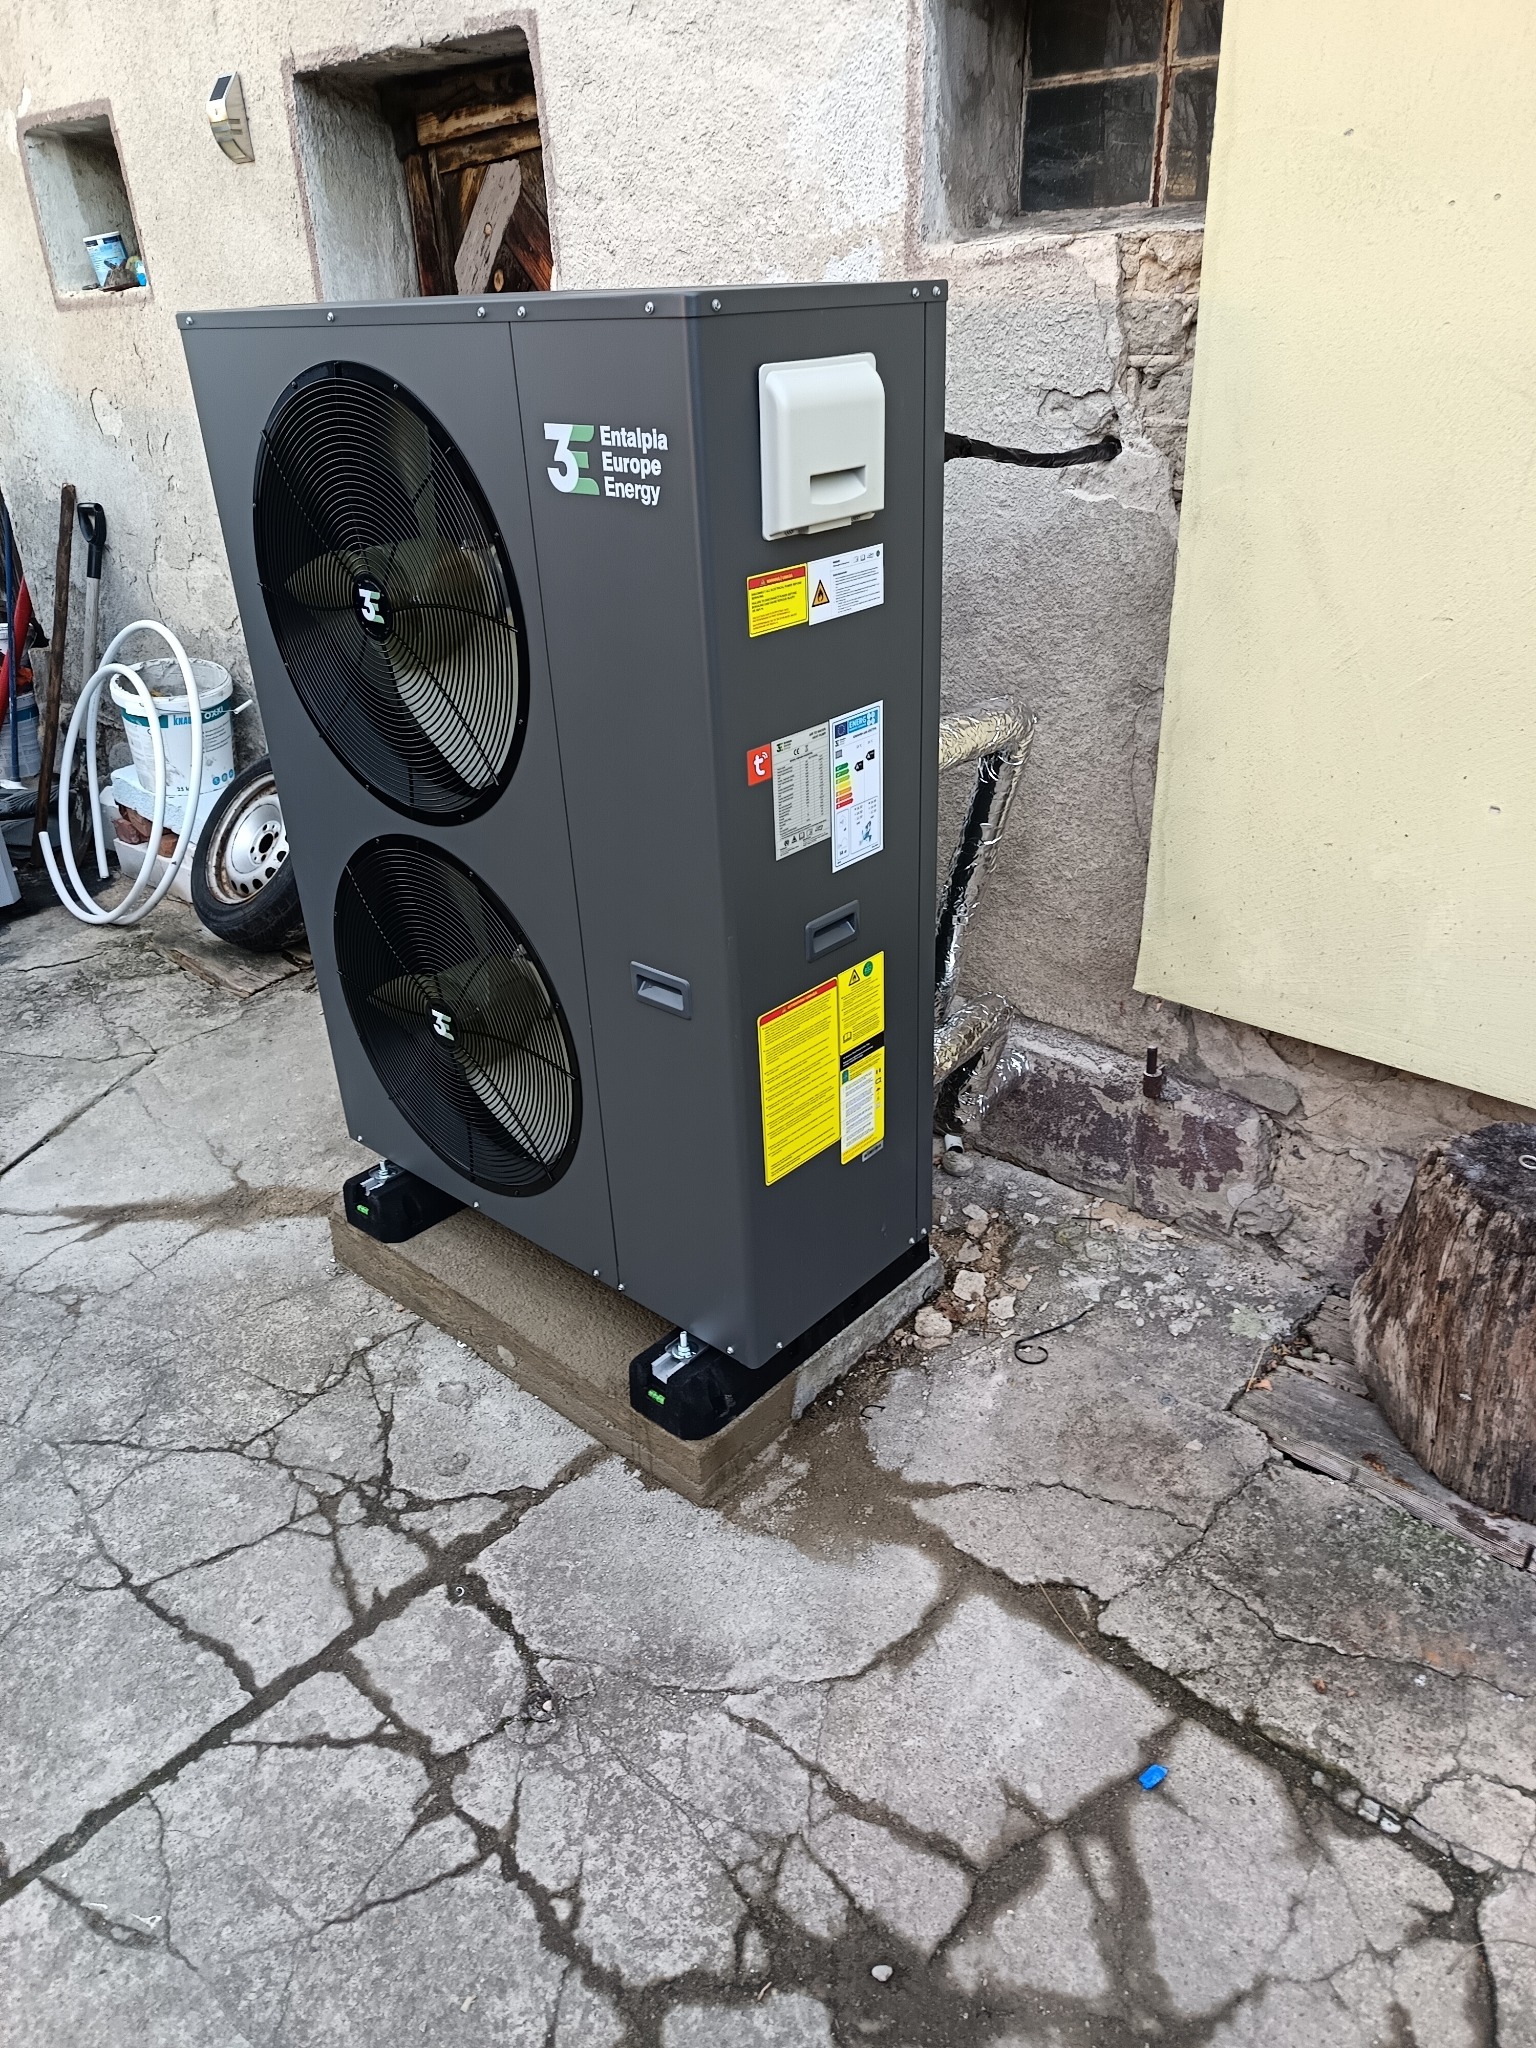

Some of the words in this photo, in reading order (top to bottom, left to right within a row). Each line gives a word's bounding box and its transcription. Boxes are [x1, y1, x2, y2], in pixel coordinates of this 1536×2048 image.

[600, 425, 668, 454] Entalpia
[601, 451, 662, 479] Europe
[604, 476, 661, 506] Energy
